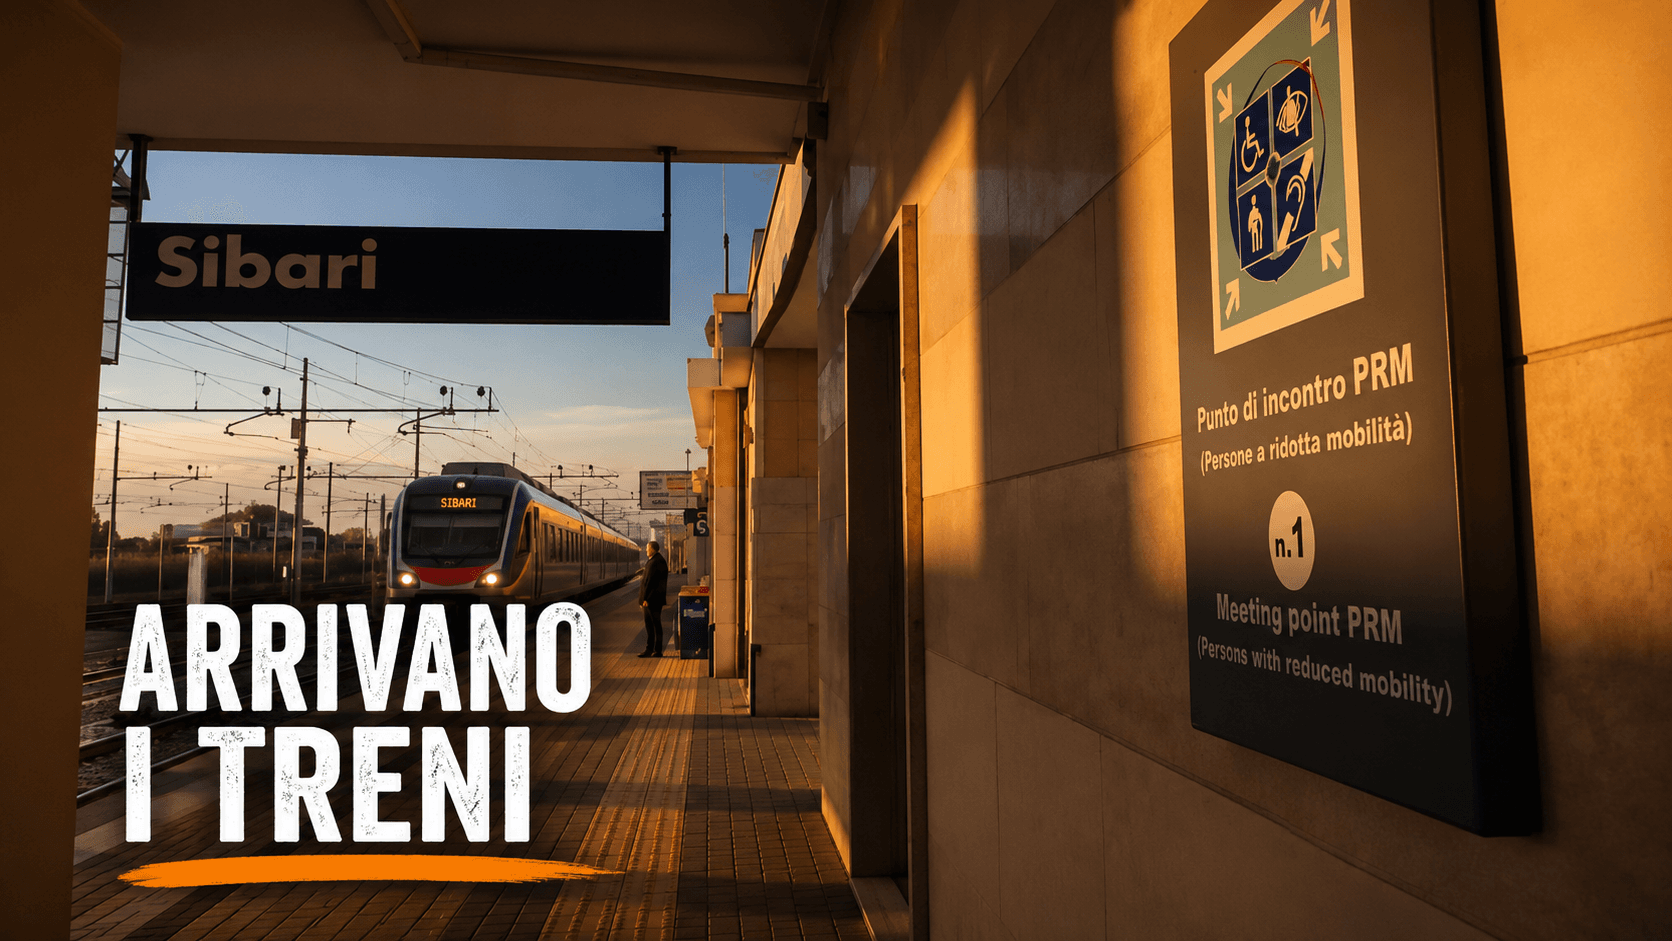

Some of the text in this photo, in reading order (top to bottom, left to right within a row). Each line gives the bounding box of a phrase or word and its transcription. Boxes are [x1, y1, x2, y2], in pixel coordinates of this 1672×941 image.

[155, 235, 378, 291] Sibari
[1197, 342, 1414, 433] Punto di incontro PRM
[1200, 410, 1413, 477] (Persone a ridotta mobilità)
[440, 497, 477, 509] SIBARI
[1275, 516, 1304, 558] n.1
[1216, 592, 1403, 645] Meeting point PRM
[1197, 634, 1453, 717] (Persons with reduced mobility)
